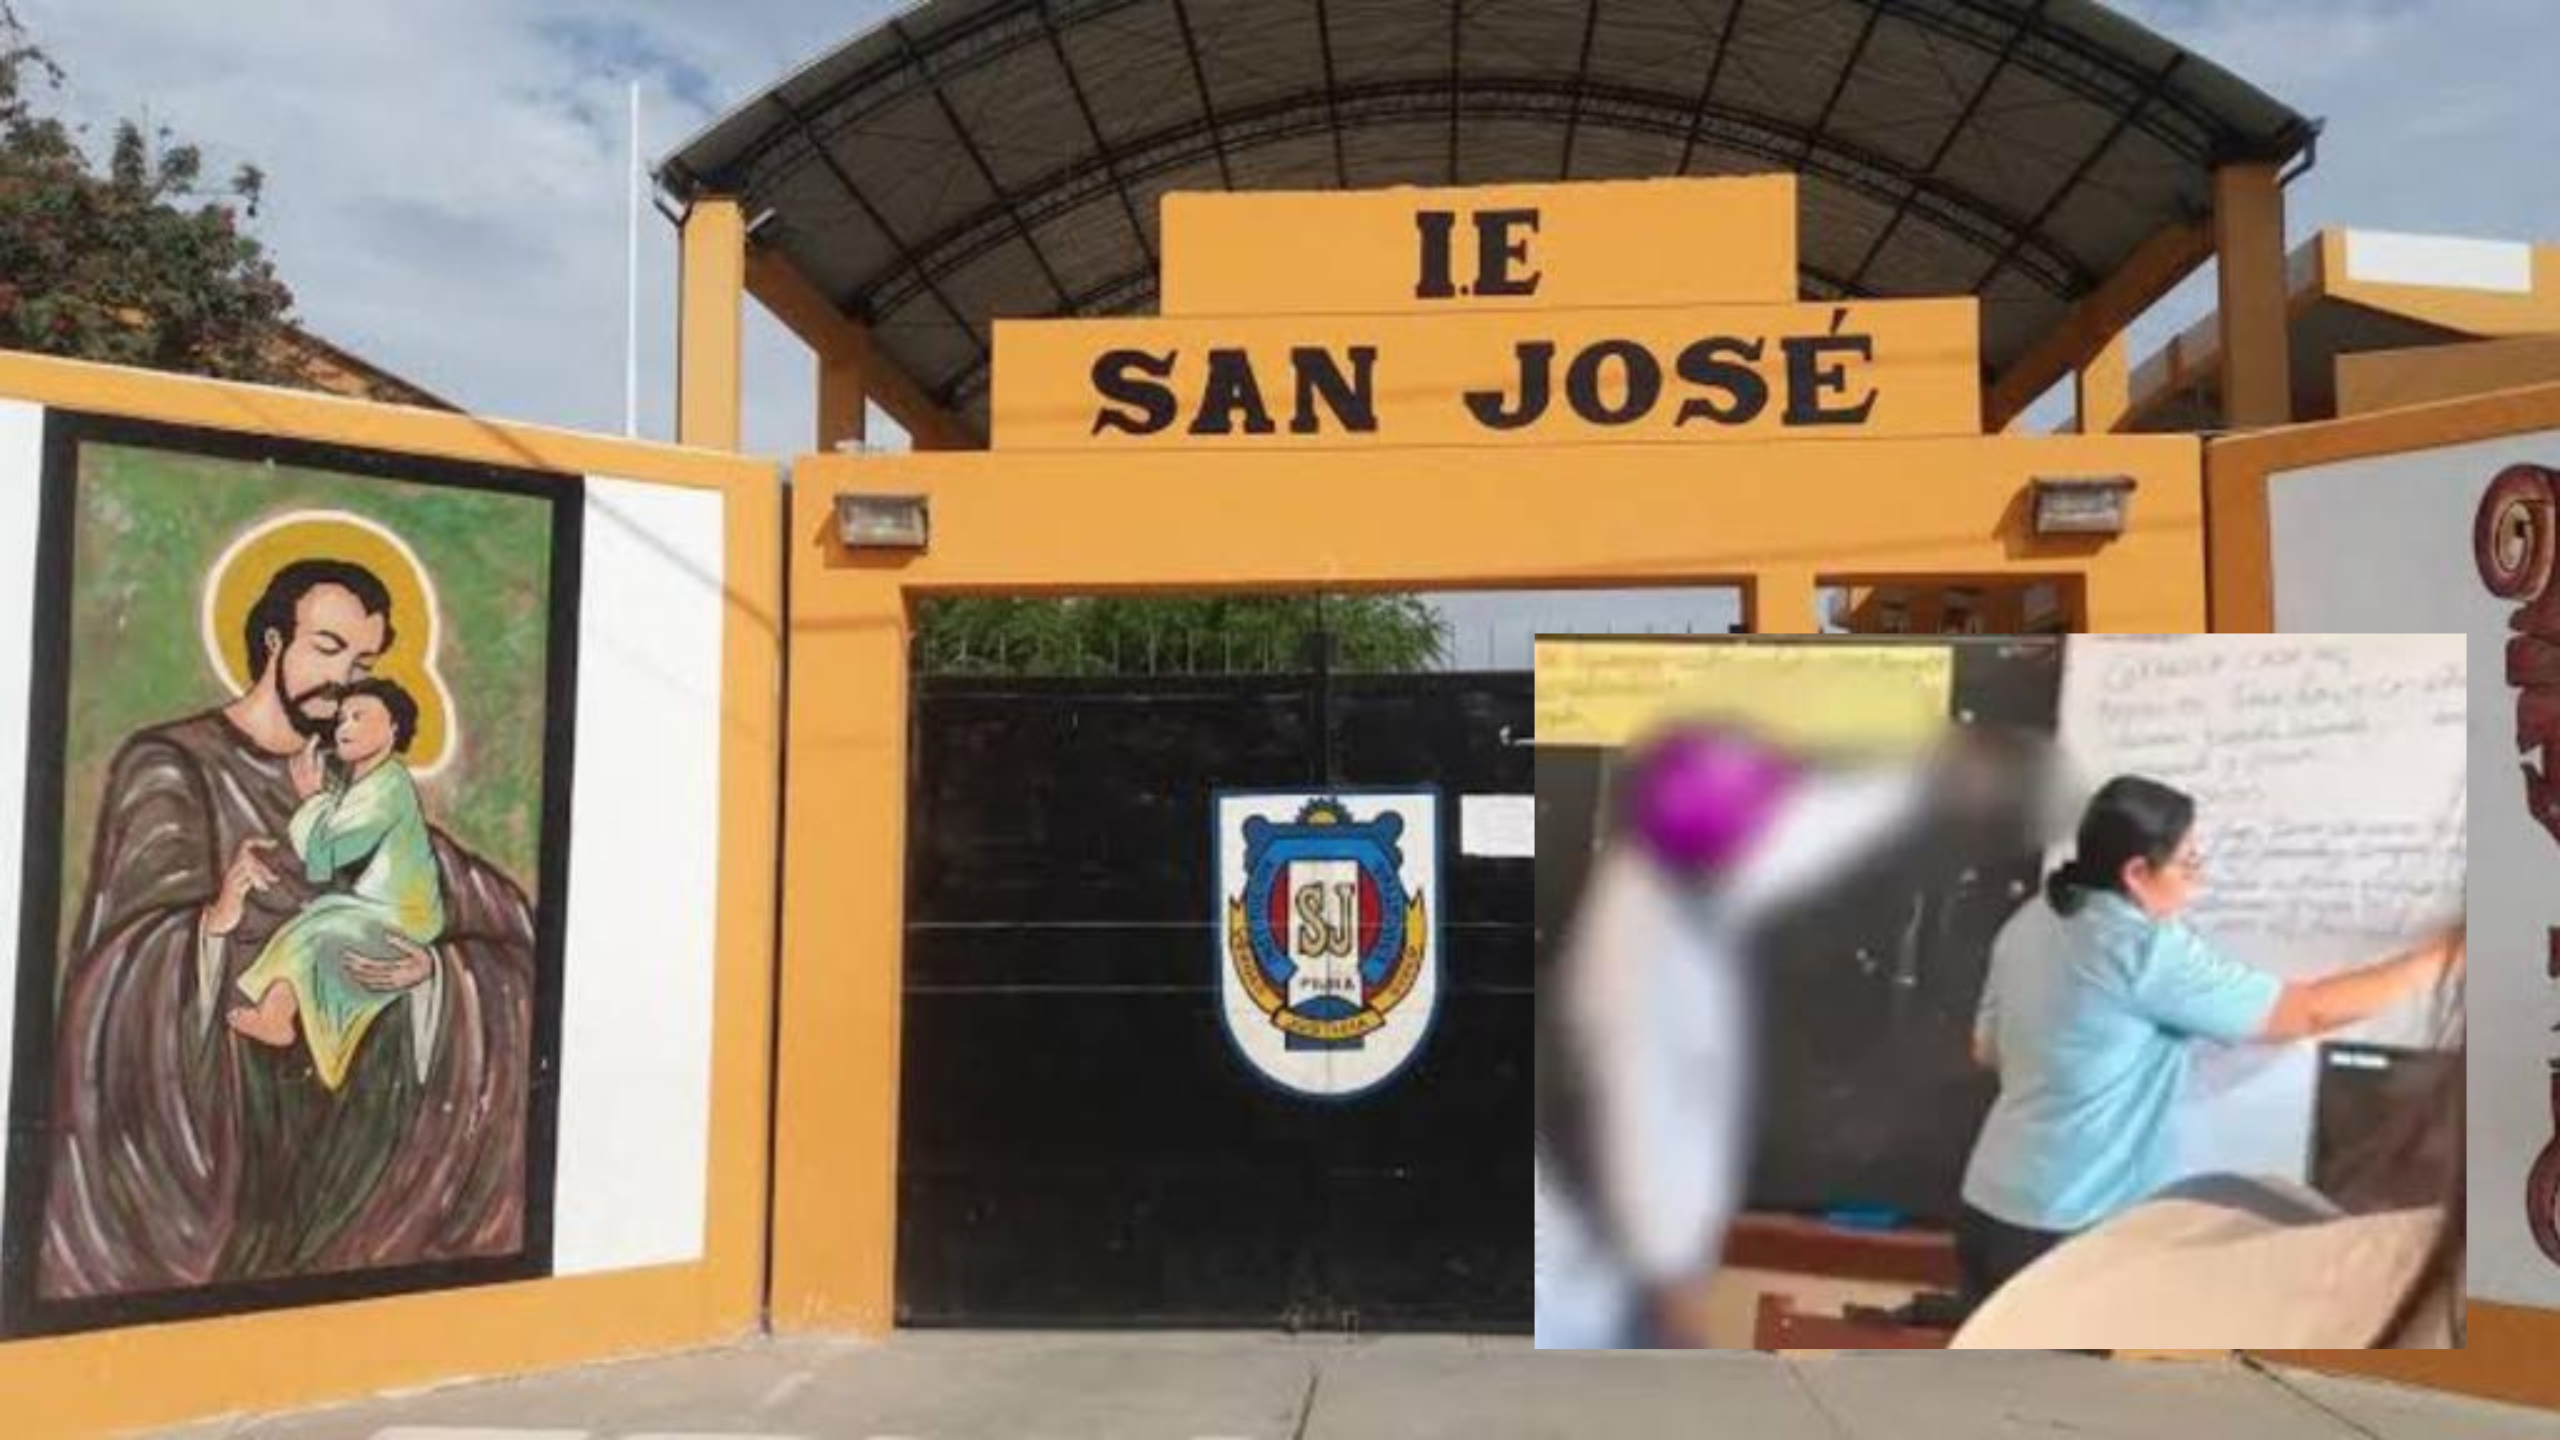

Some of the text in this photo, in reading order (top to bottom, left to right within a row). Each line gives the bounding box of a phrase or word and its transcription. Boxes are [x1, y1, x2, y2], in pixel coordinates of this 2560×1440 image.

[1415, 208, 1540, 299] I.E
[1091, 308, 1878, 436] SAN JOSÉ
[1295, 881, 1356, 958] SJ
